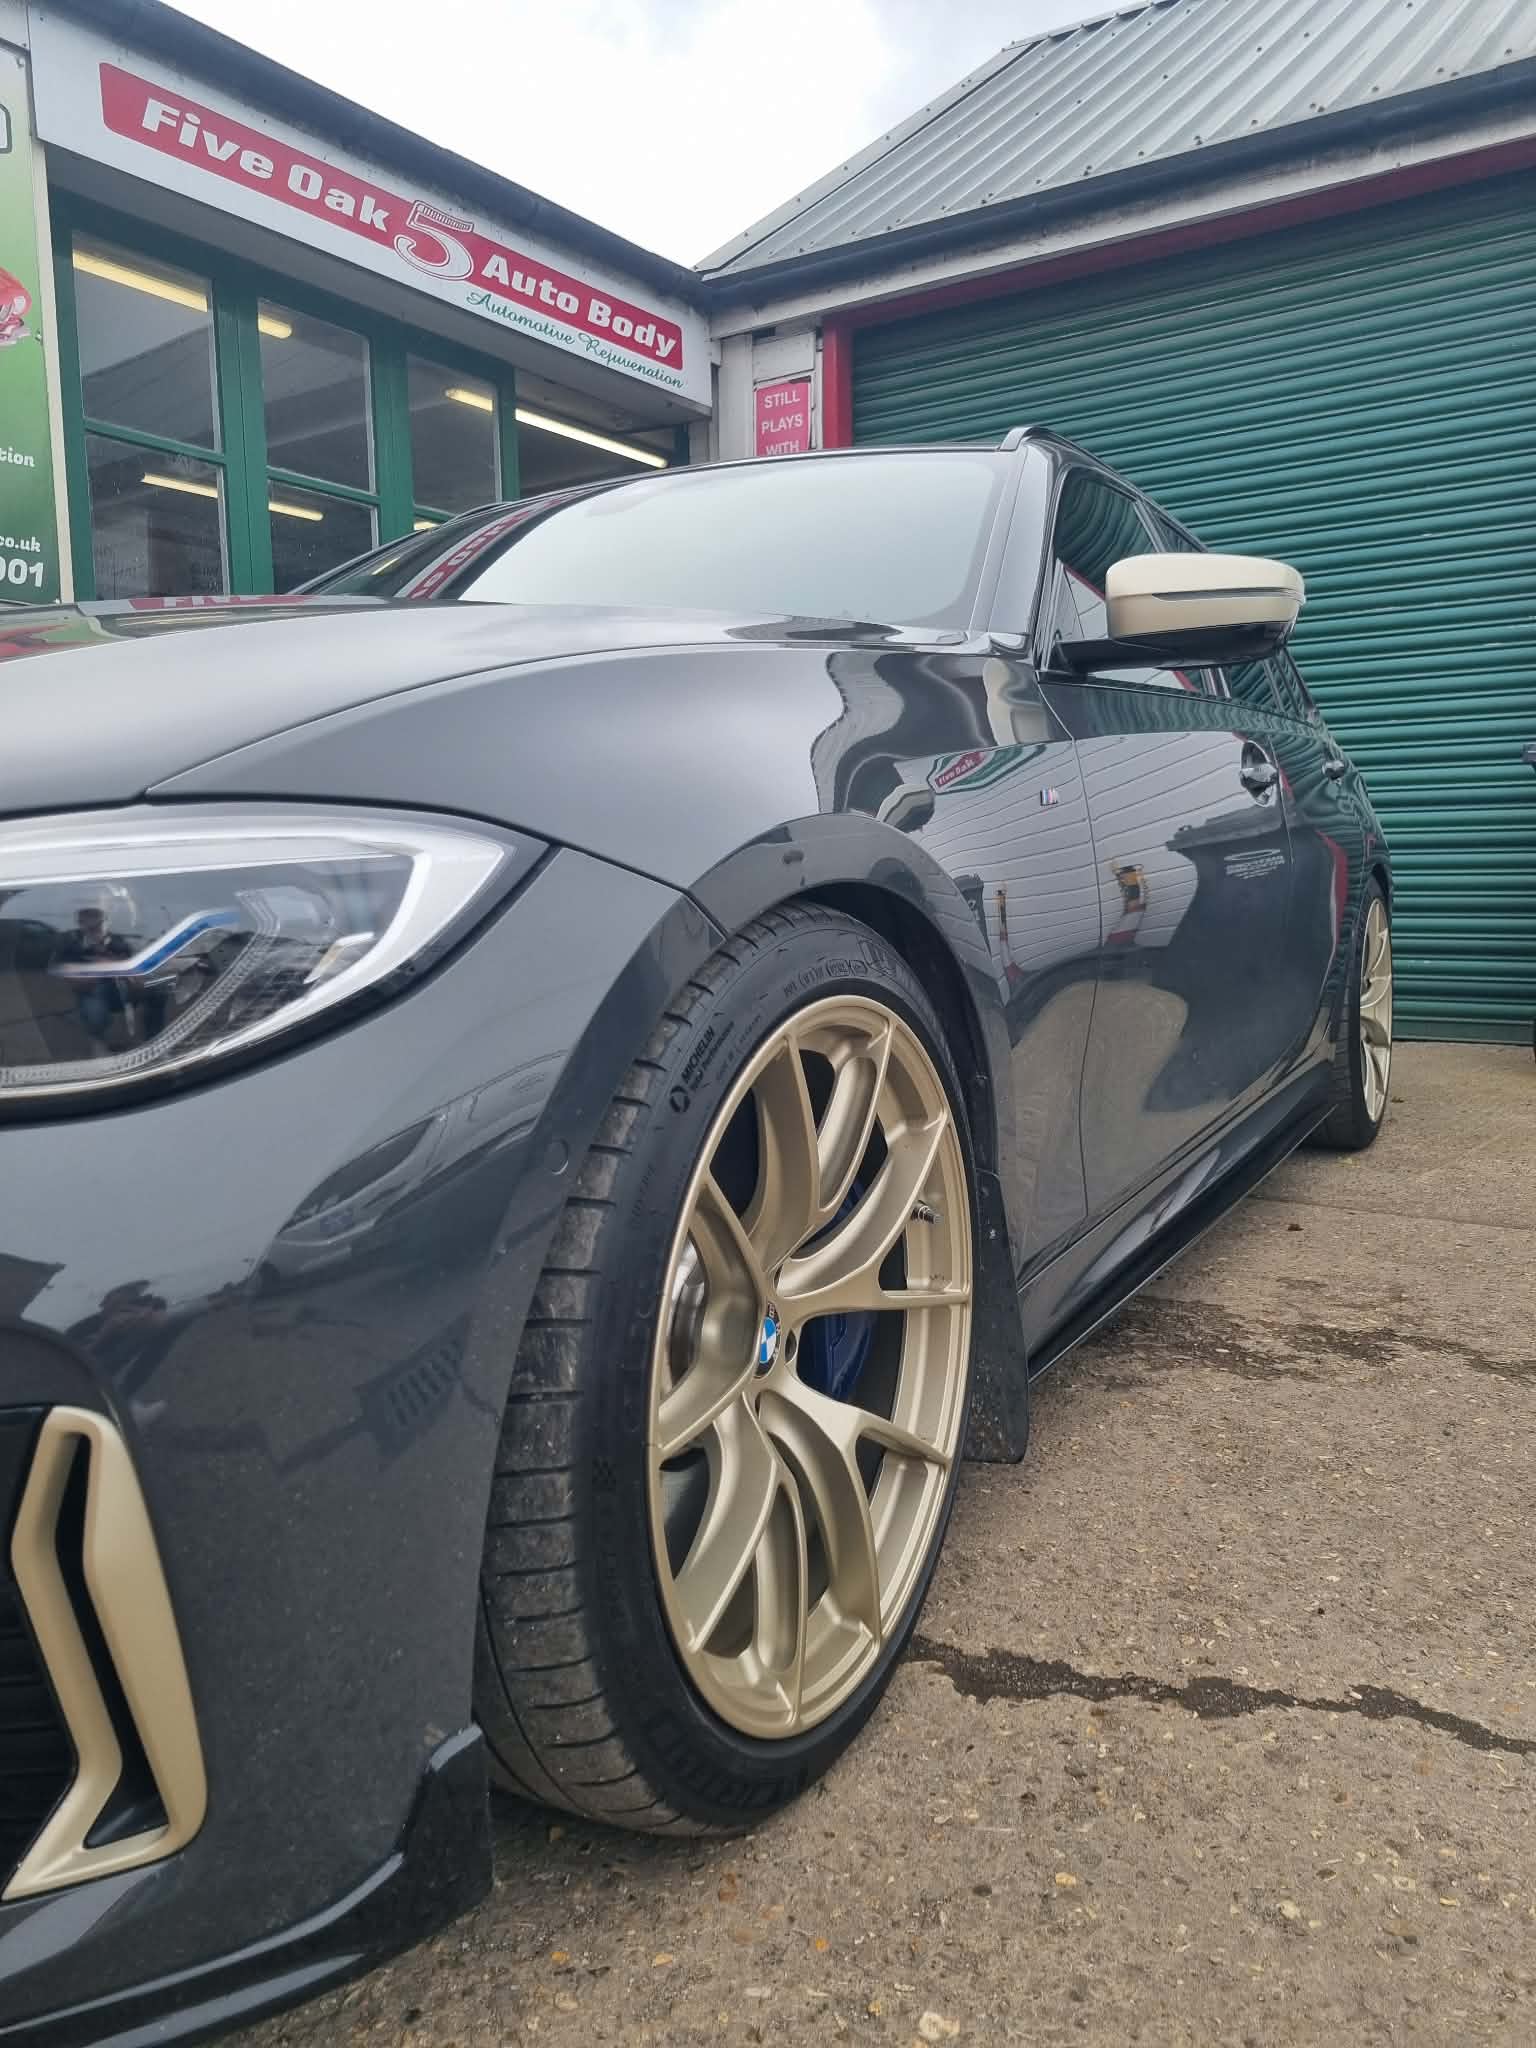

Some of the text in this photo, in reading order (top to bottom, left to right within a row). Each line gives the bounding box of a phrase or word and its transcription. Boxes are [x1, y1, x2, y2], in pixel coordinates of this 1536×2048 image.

[142, 98, 677, 358] Five Oak 5 Auto Body
[466, 291, 685, 389] Automotive Rejuvenation
[764, 390, 801, 409] STILL
[761, 413, 804, 435] PLAYS
[765, 439, 800, 456] WITH
